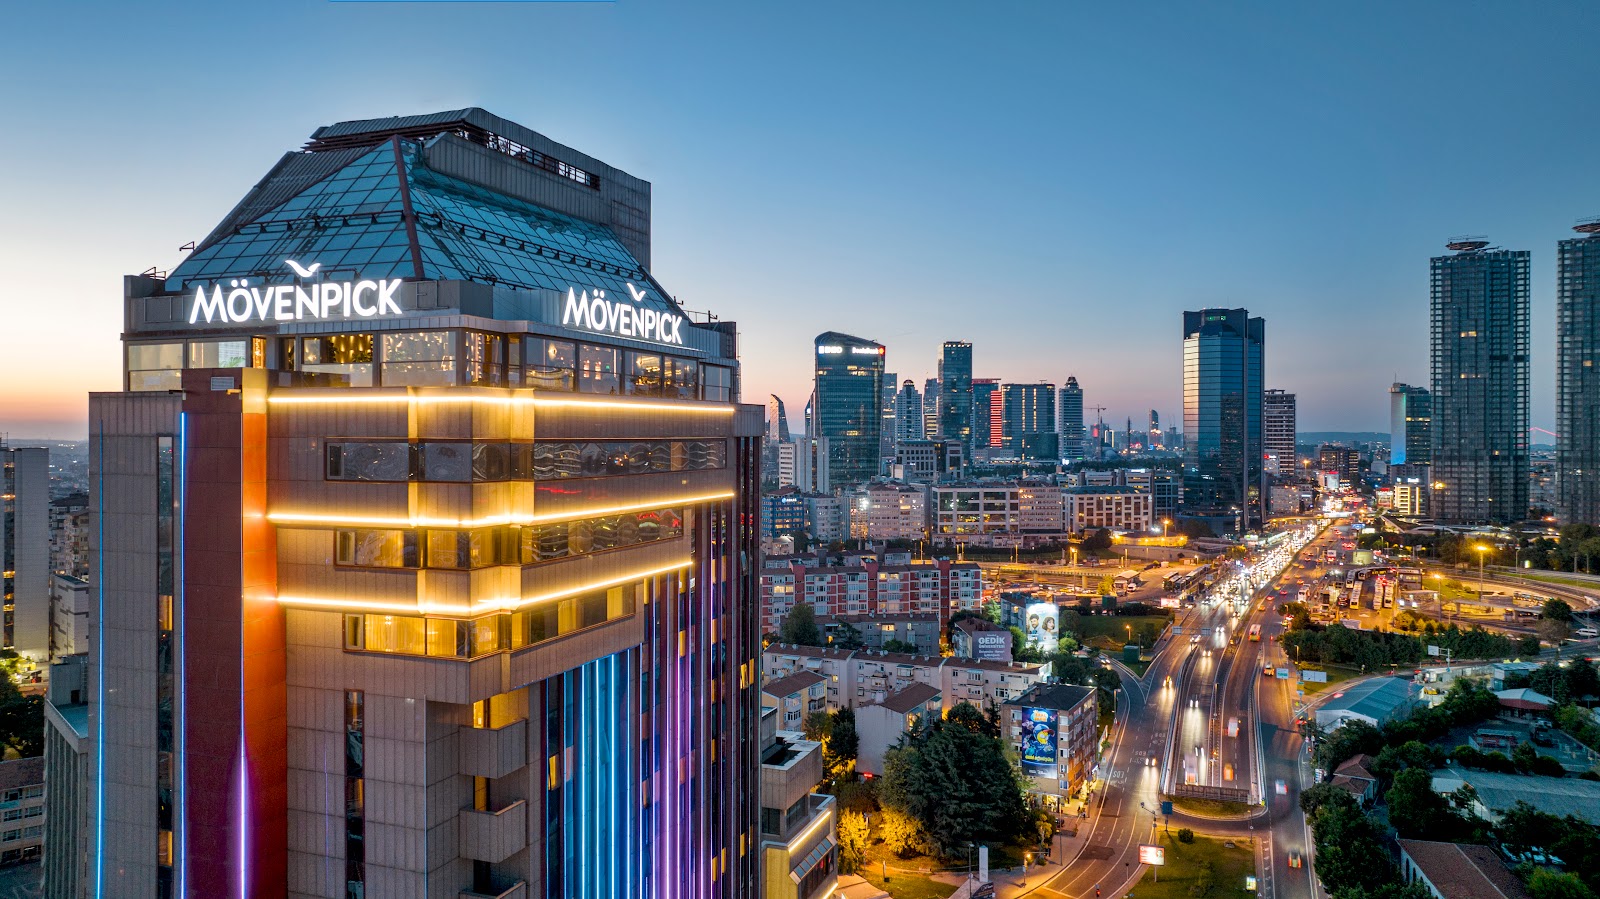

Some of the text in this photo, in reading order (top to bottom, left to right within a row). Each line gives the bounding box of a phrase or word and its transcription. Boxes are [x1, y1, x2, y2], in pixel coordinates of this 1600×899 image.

[189, 279, 403, 324] MÖVENPICK
[562, 286, 683, 345] MÖVENPICK
[978, 635, 1006, 644] GEDİK
